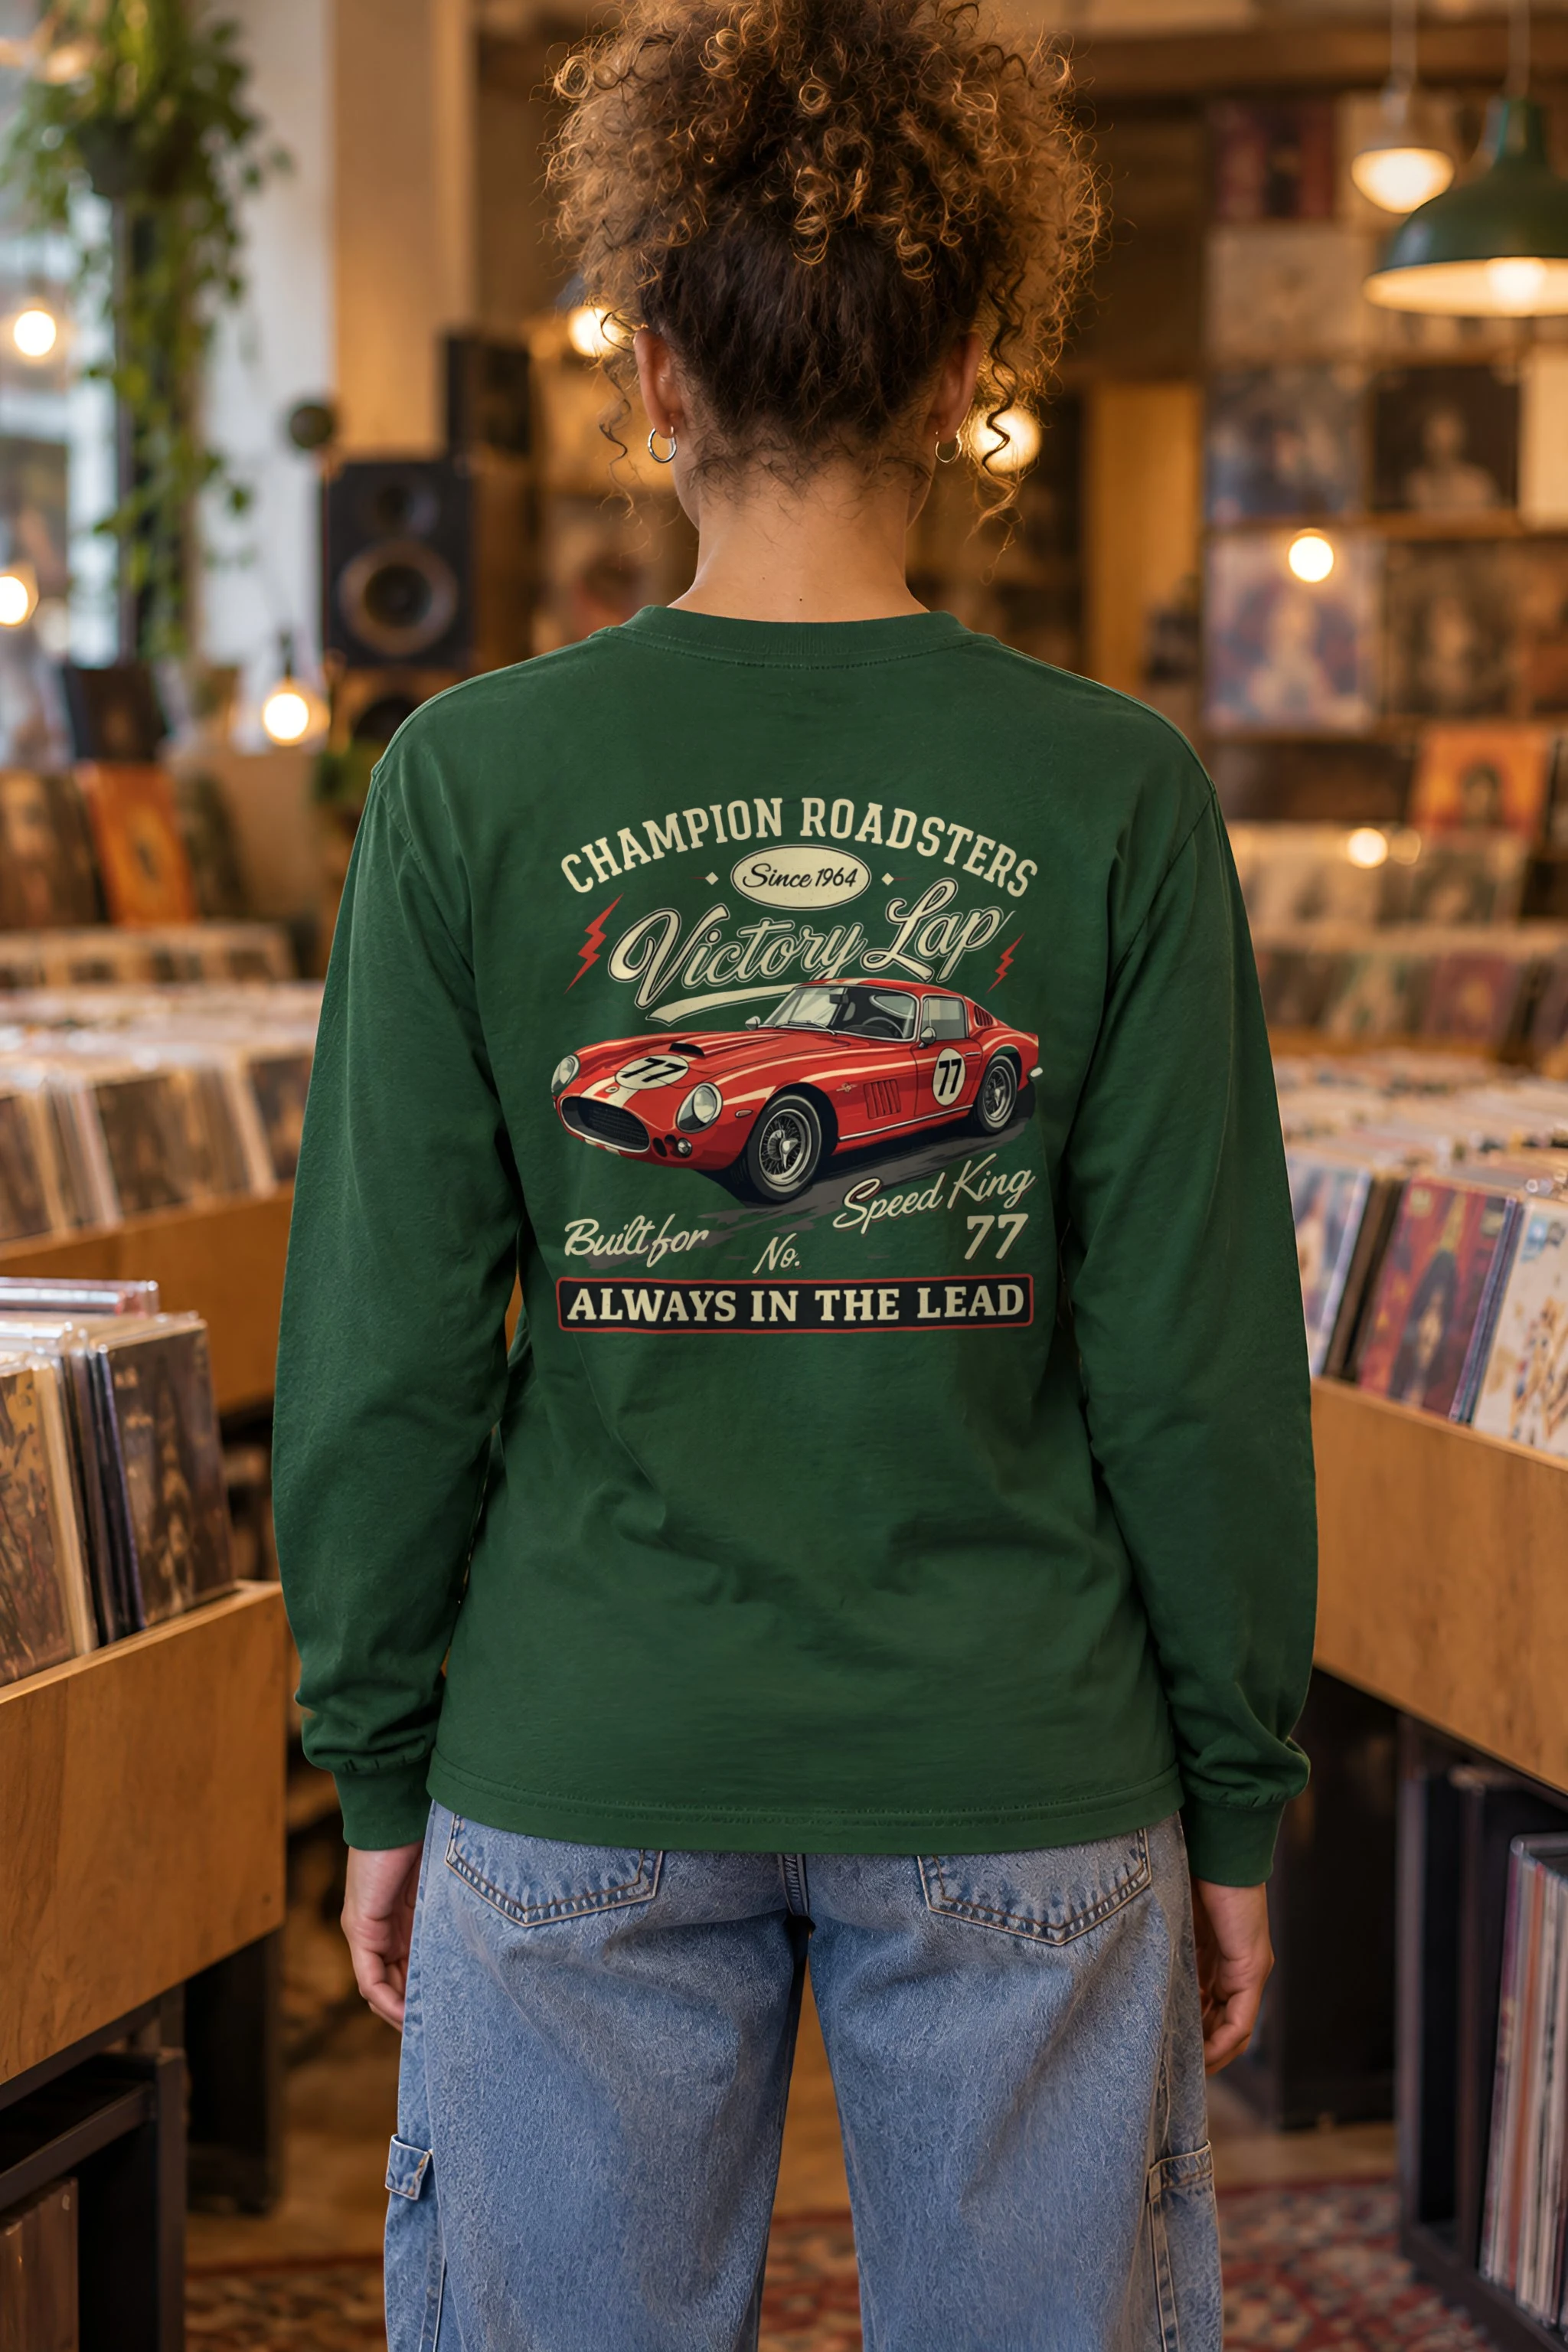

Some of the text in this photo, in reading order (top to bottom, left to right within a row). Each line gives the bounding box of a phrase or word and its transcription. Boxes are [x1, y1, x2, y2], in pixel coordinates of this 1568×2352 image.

[560, 796, 1039, 897] CHAMPION ROADSTERS
[742, 863, 858, 889] Since 1964
[608, 877, 1016, 1009] Victory Lap
[620, 1057, 688, 1083] 77
[936, 1054, 963, 1097] 77
[833, 1153, 1036, 1234] Speed King
[564, 1214, 710, 1268] Built for
[752, 1233, 801, 1275] No.
[964, 1213, 1029, 1261] 77
[567, 1284, 1025, 1323] ALWAYS IN THE LEAD
